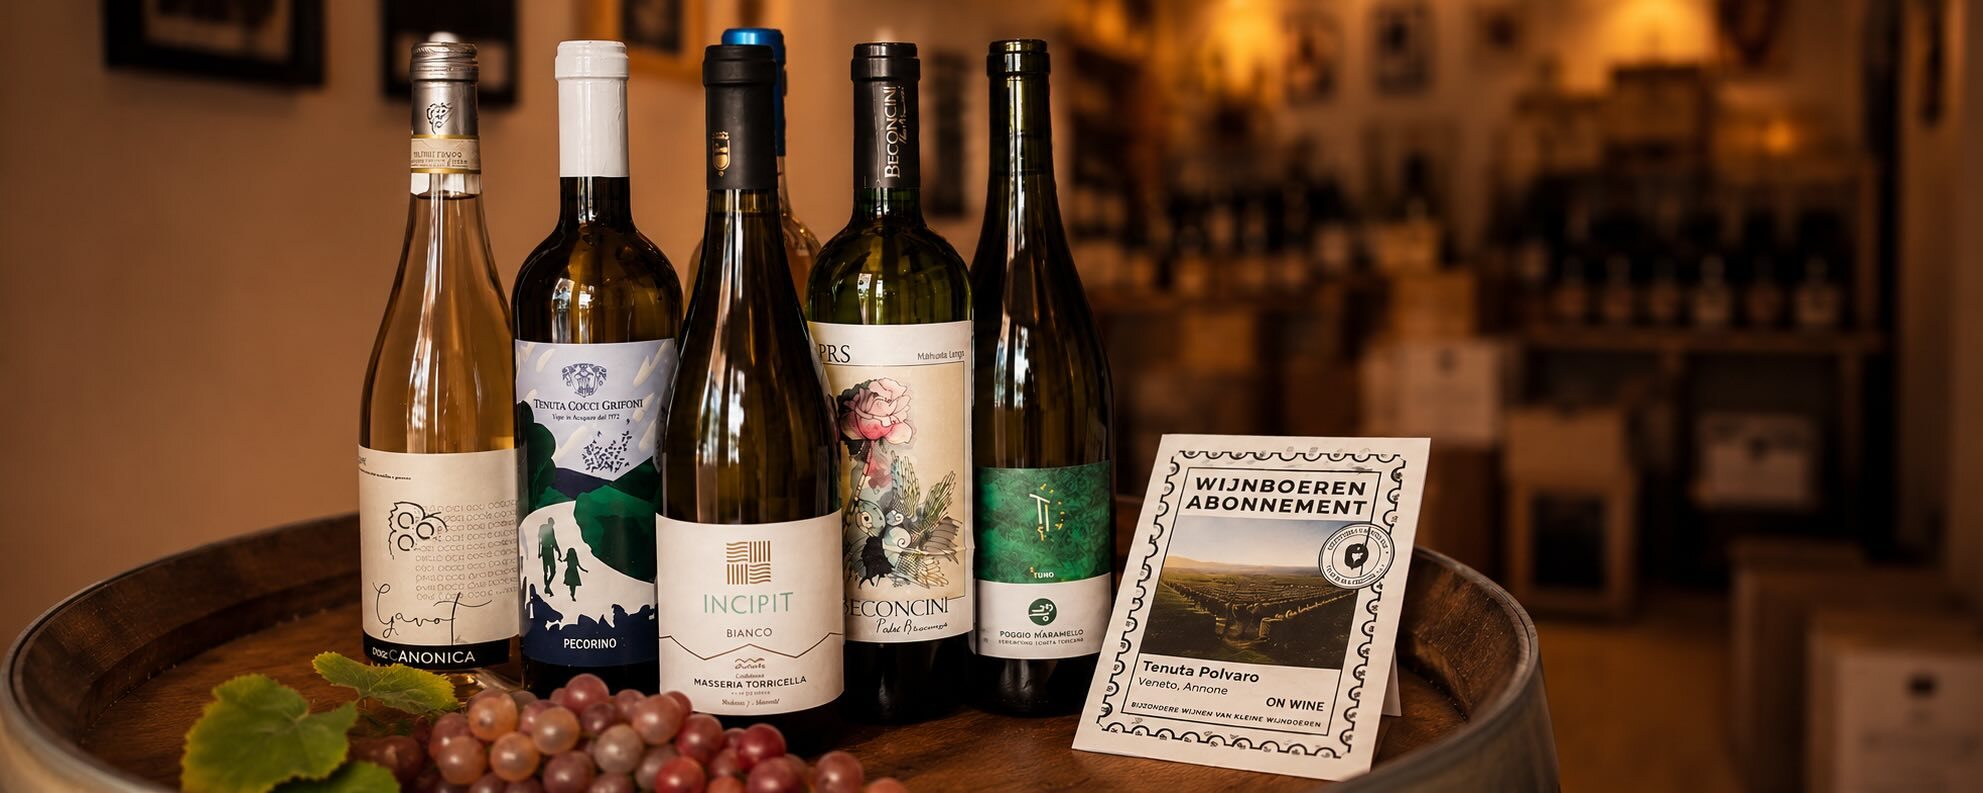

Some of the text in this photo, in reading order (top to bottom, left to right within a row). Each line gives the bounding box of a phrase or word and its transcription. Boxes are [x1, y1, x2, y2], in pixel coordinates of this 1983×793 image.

[883, 86, 900, 178] BECONCINI
[534, 398, 643, 412] TENUTA COCCI GRIFONI
[1196, 477, 1366, 496] WIJNBOEREN
[1185, 495, 1367, 516] ABONNEMENT
[703, 592, 794, 615] INCIPIT
[726, 628, 773, 638] BIANCO
[1000, 630, 1031, 639] POGGIO
[563, 638, 617, 650] PECORINO
[388, 648, 476, 664] CANONICA
[1143, 660, 1260, 683] Tenuta Polvaro
[693, 678, 743, 689] MASSERIA
[746, 675, 808, 689] TORRICELLA
[1138, 677, 1229, 696] Veneto, Annone
[1131, 701, 1180, 713] BIJZONDERE
[1181, 707, 1213, 717] WIJNEN
[1215, 711, 1232, 719] VAN
[1233, 713, 1264, 723] KLEINE
[1265, 697, 1325, 712] ON WINE
